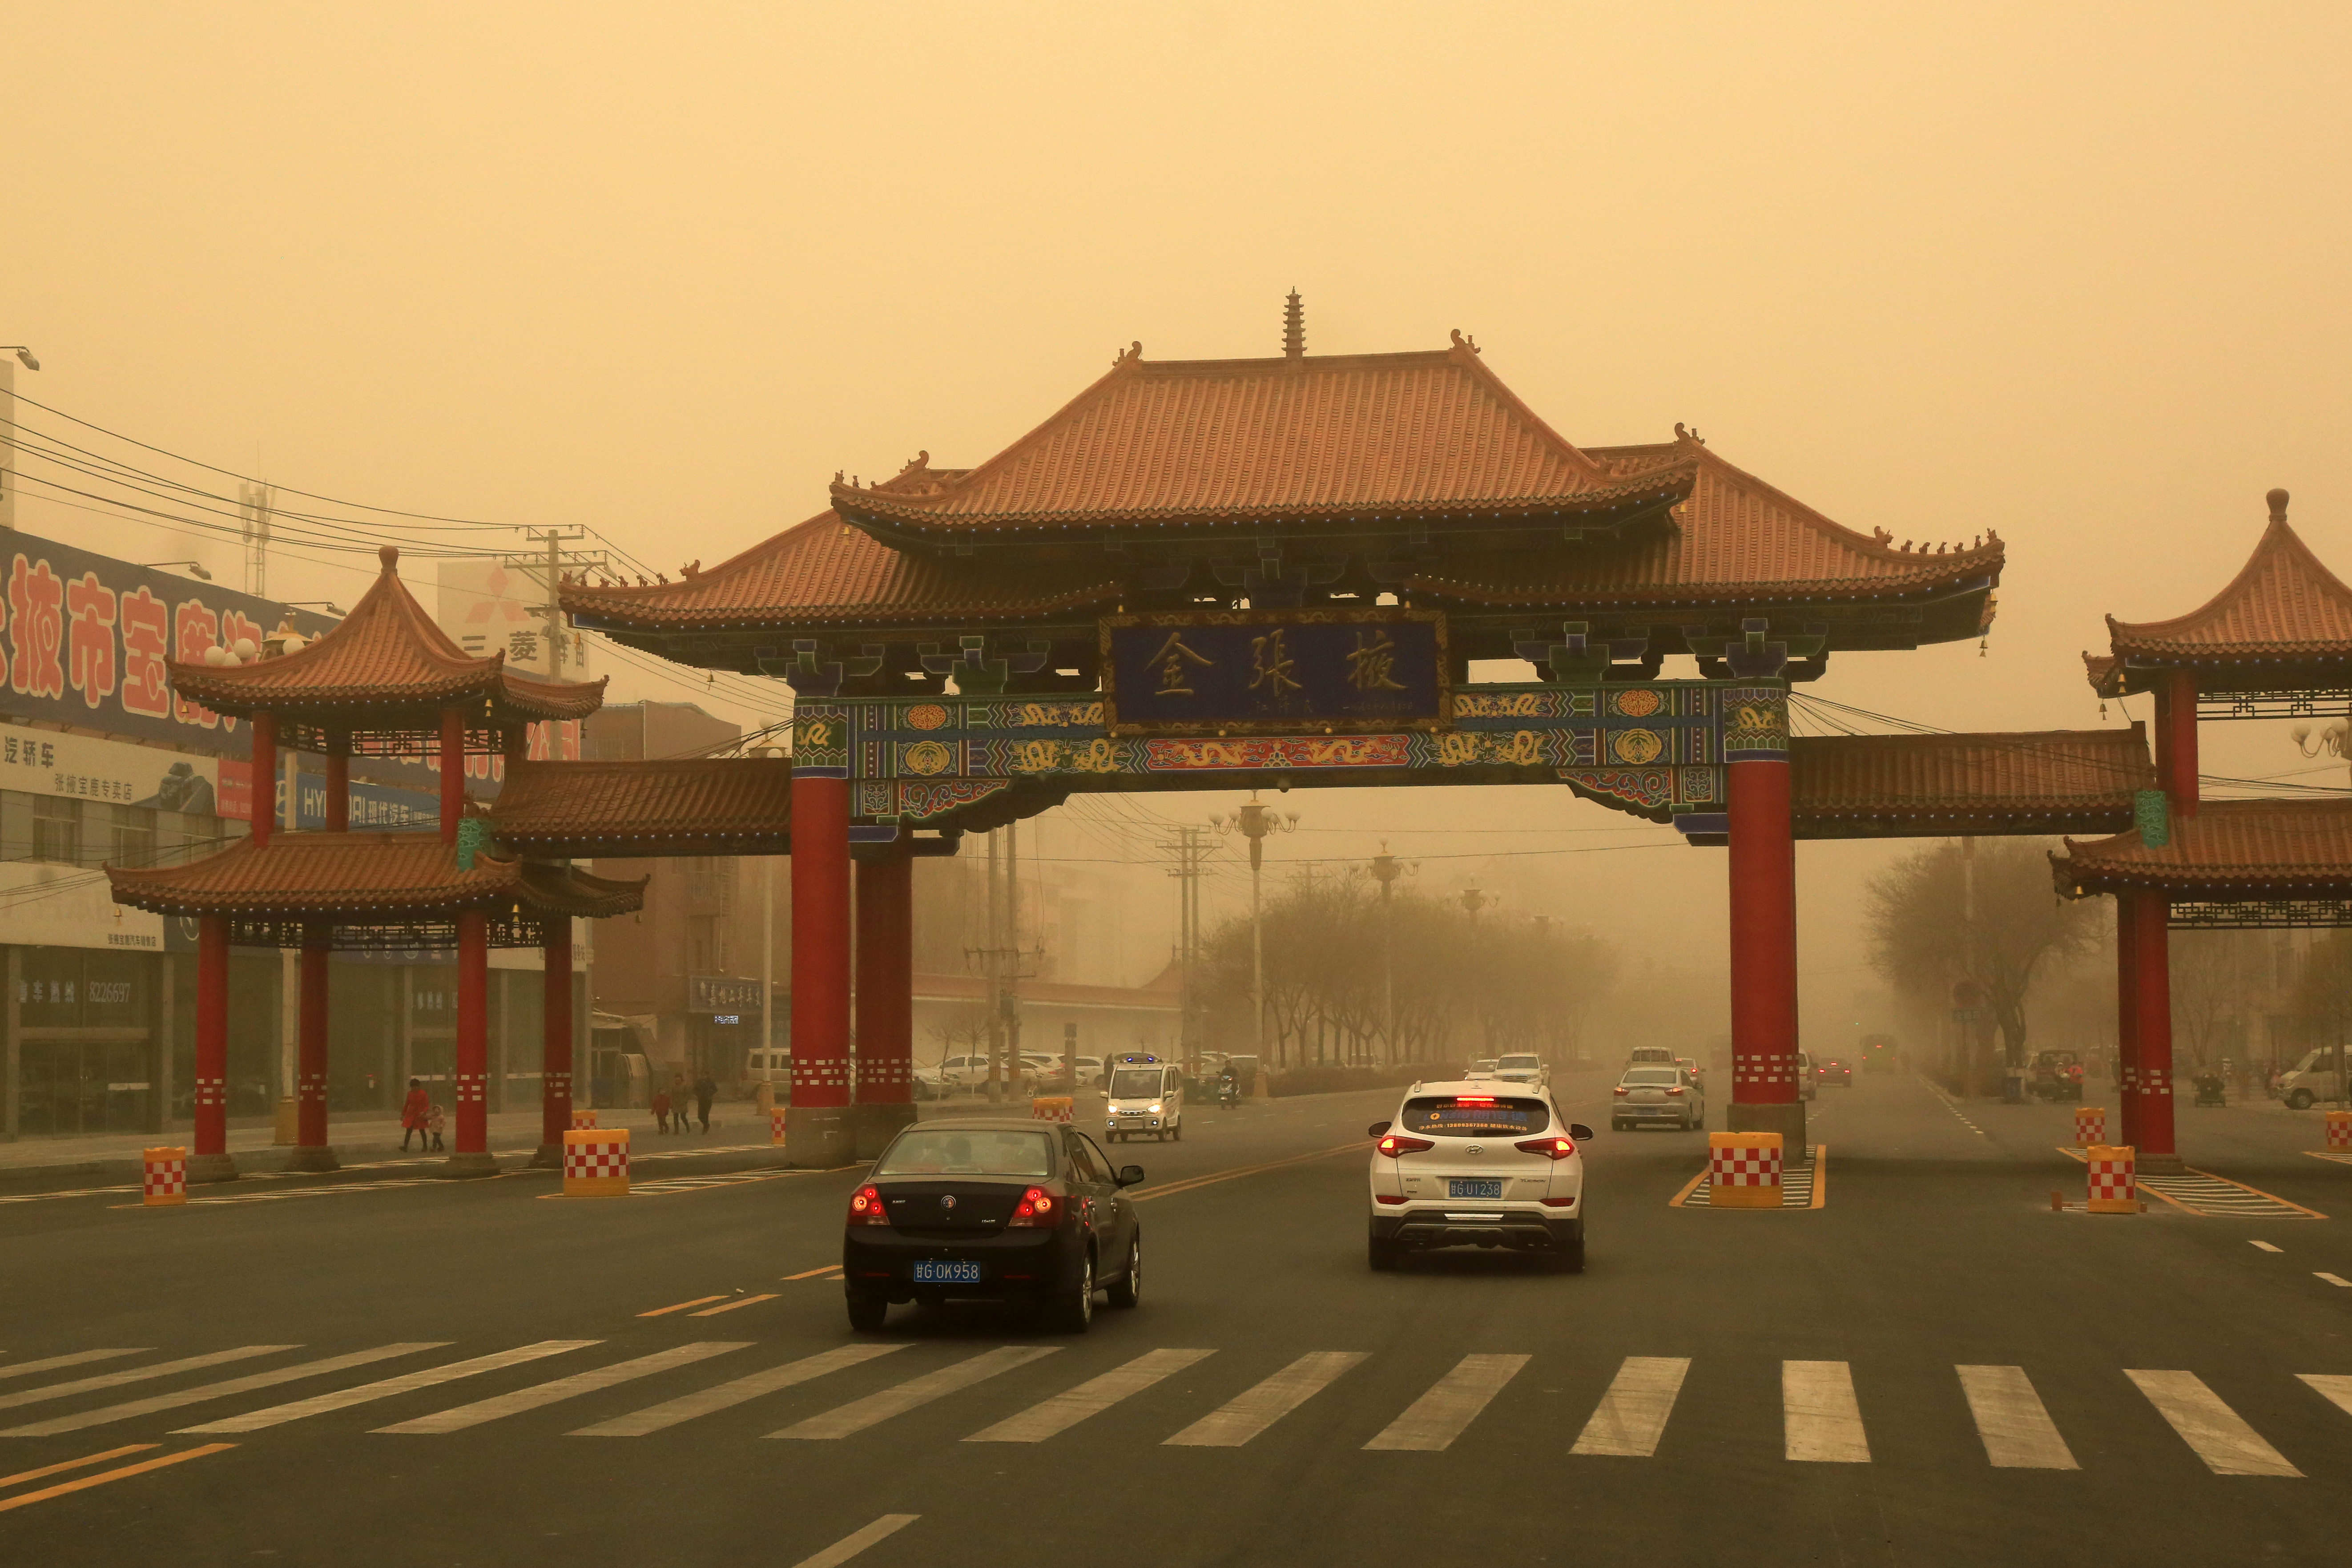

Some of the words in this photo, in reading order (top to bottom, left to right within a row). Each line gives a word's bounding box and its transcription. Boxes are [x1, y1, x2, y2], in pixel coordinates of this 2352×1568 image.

[55, 773, 133, 801] 张掖宝鹿专卖店
[303, 787, 364, 824] HYAI
[89, 981, 130, 1003] 8226697
